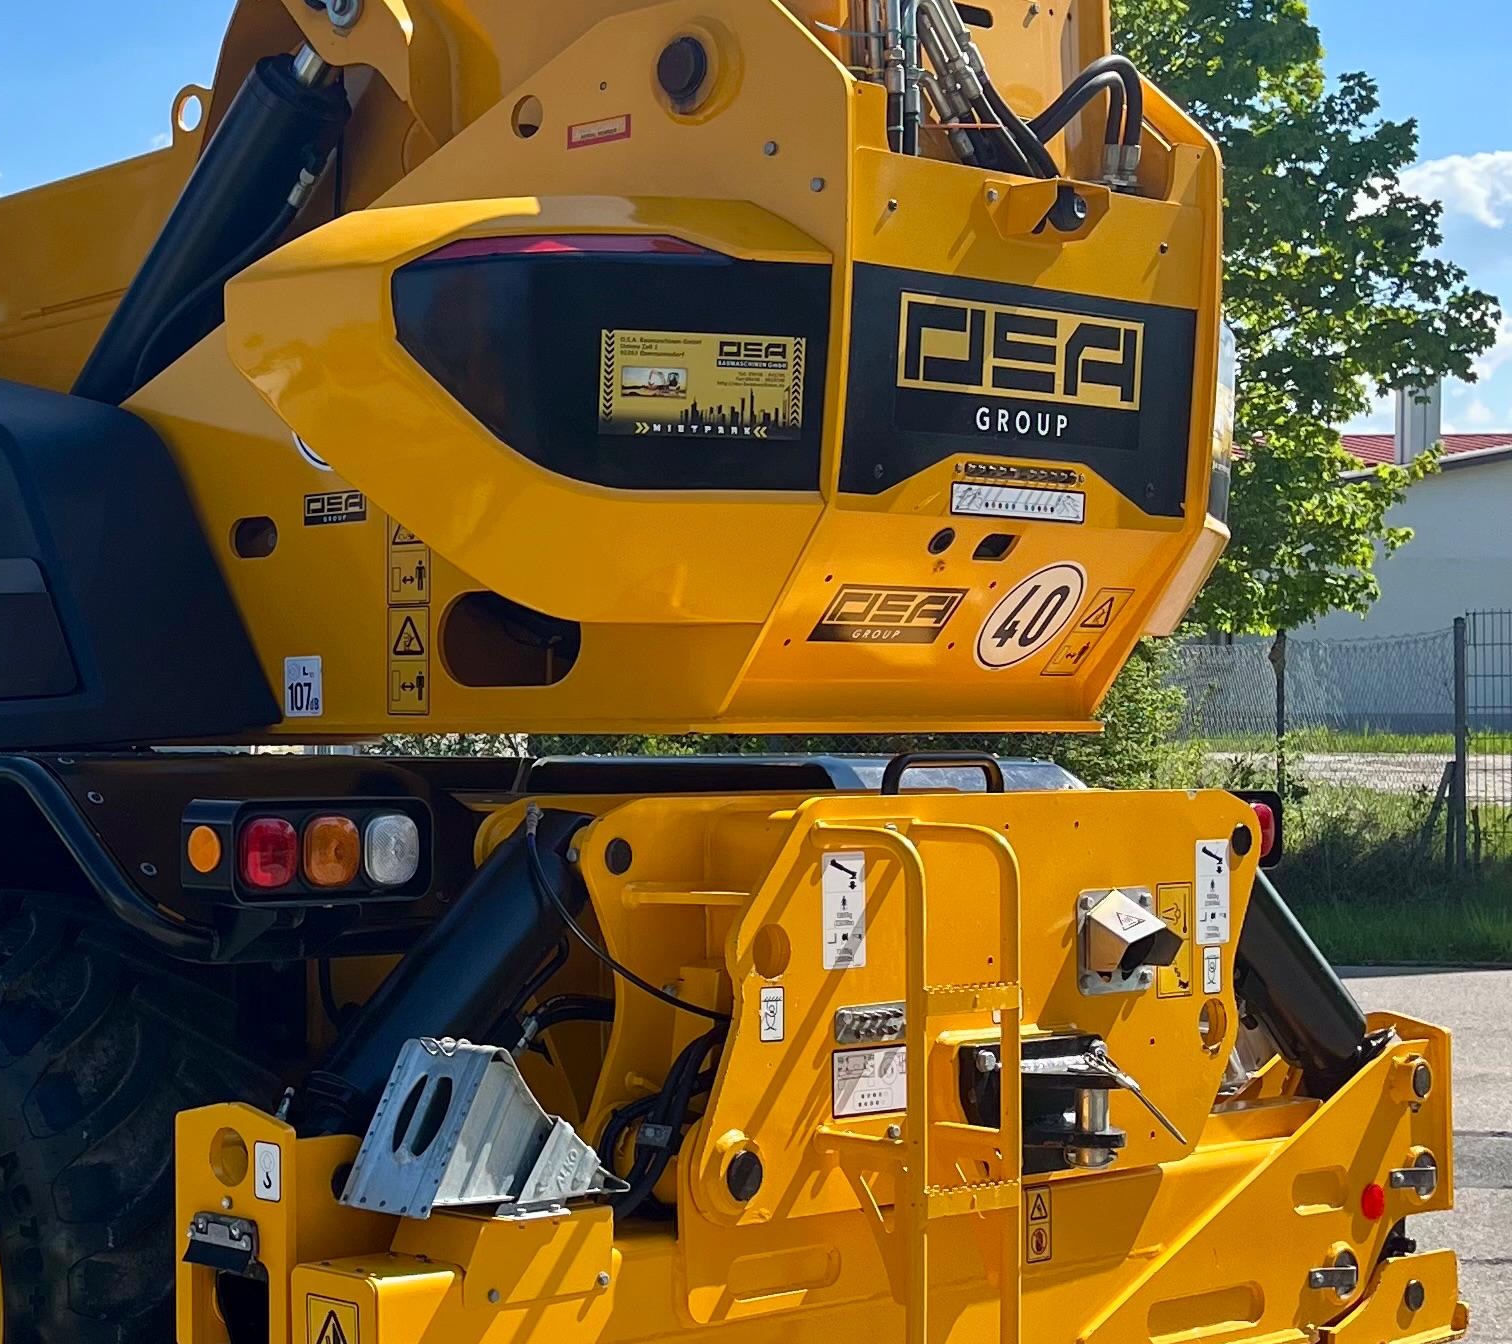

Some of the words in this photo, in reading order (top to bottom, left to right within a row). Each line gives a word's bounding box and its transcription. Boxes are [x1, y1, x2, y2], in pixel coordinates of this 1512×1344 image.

[975, 407, 1068, 437] GROUP
[991, 584, 1071, 648] 40
[852, 629, 901, 640] GROUP
[288, 682, 312, 711] 107
